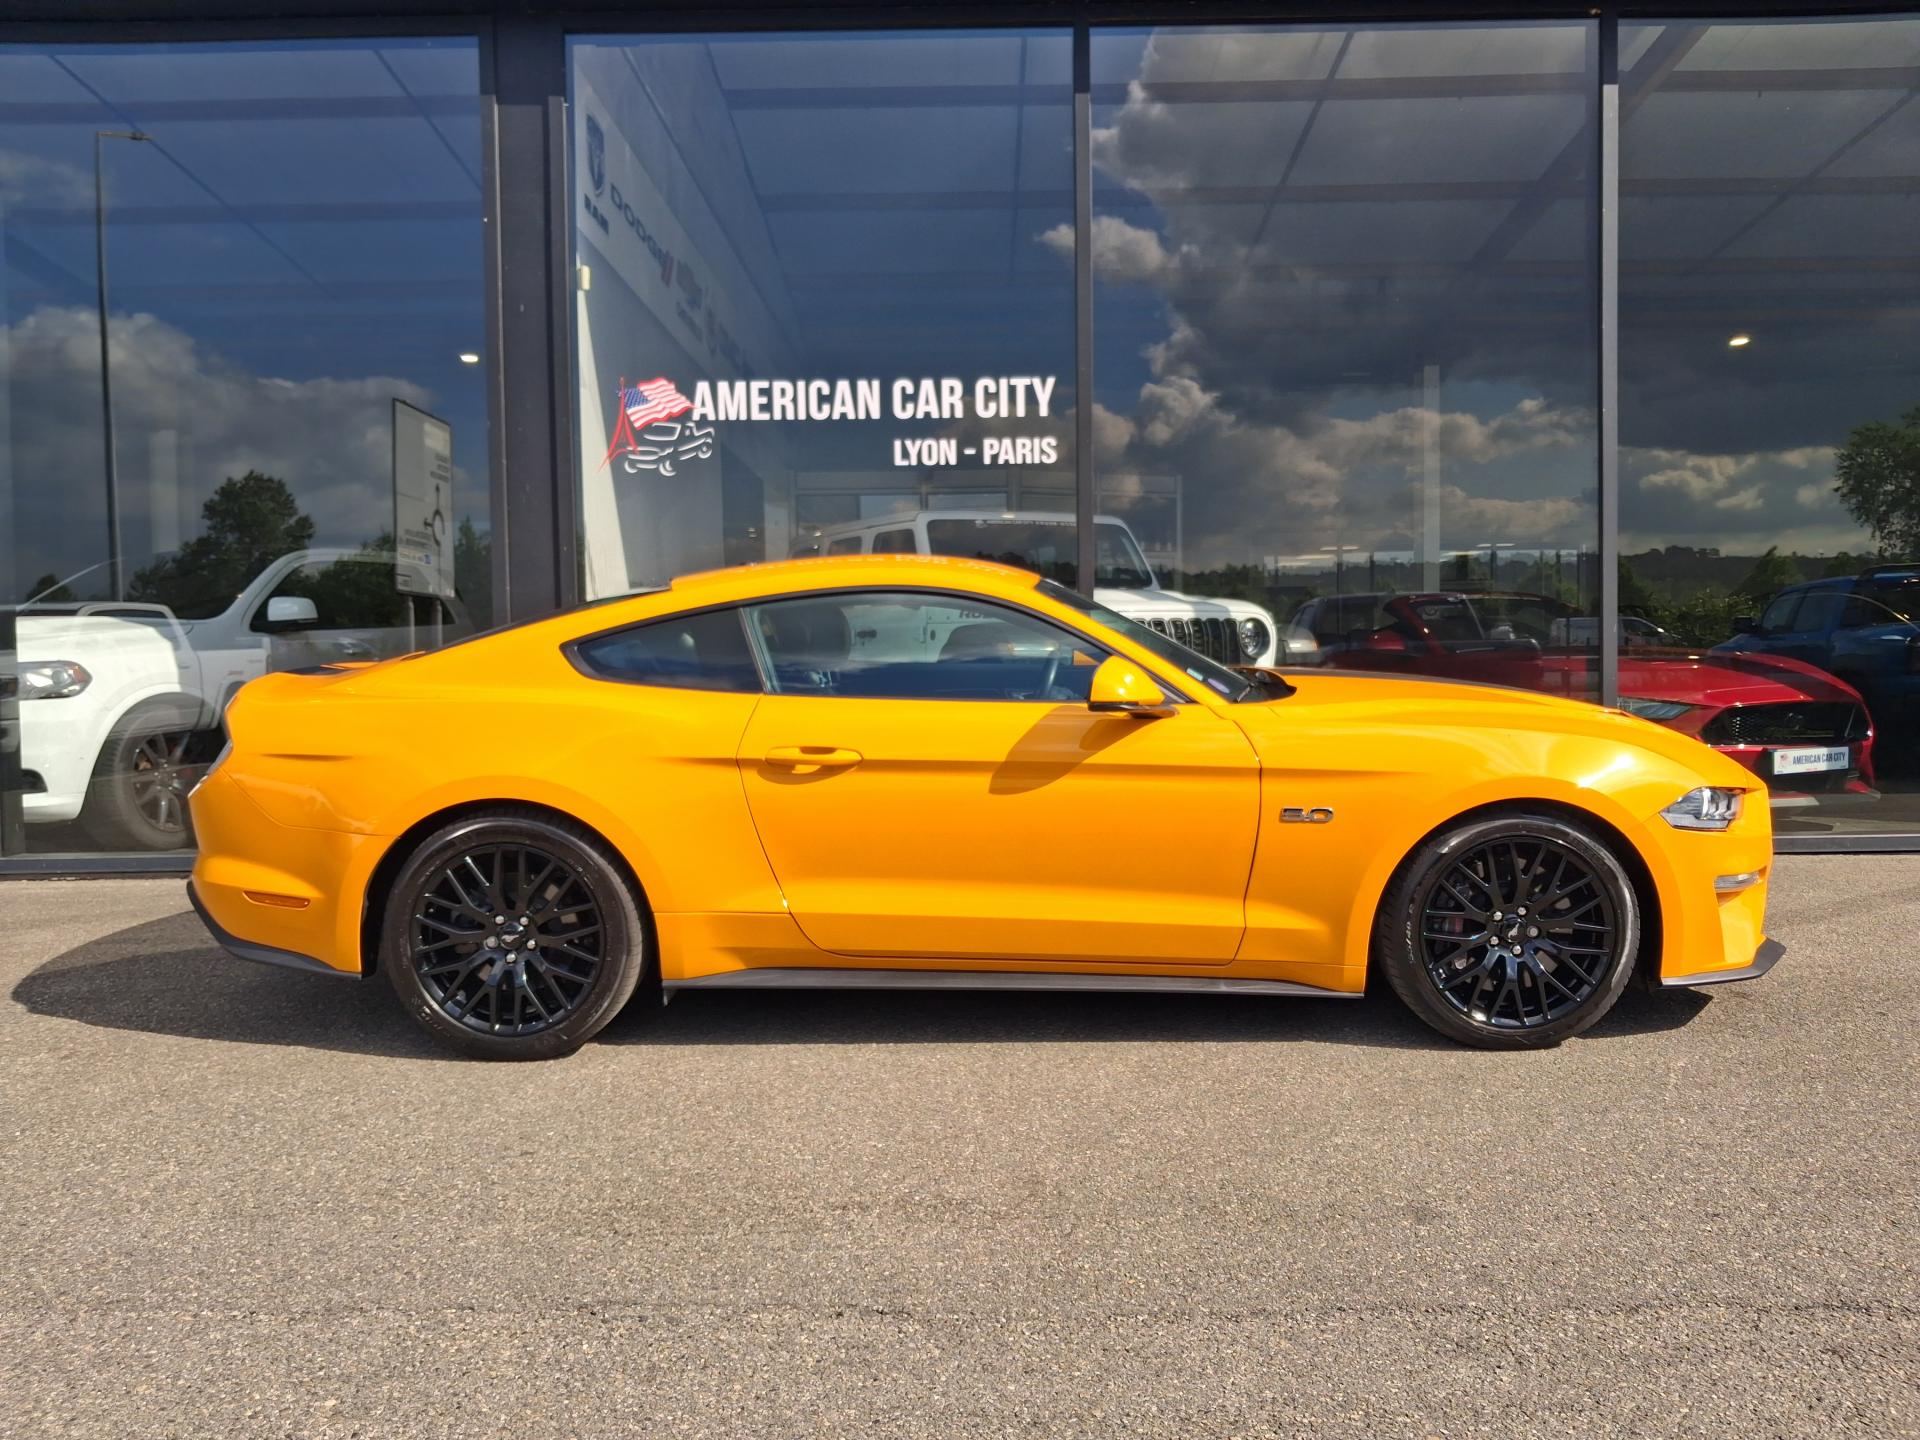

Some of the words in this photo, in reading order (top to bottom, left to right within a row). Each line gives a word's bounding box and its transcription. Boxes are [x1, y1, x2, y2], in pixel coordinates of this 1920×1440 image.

[692, 379, 882, 421] AMERICAN
[892, 378, 964, 420] CAR
[975, 376, 1057, 418] CITY
[893, 439, 957, 467] LYON
[964, 447, 976, 455] -
[983, 437, 1058, 465] PARIS
[1792, 754, 1821, 765] AMERICAN
[1821, 753, 1833, 762] CAR
[1833, 751, 1846, 761] CITY
[1280, 807, 1333, 822] 5.0
